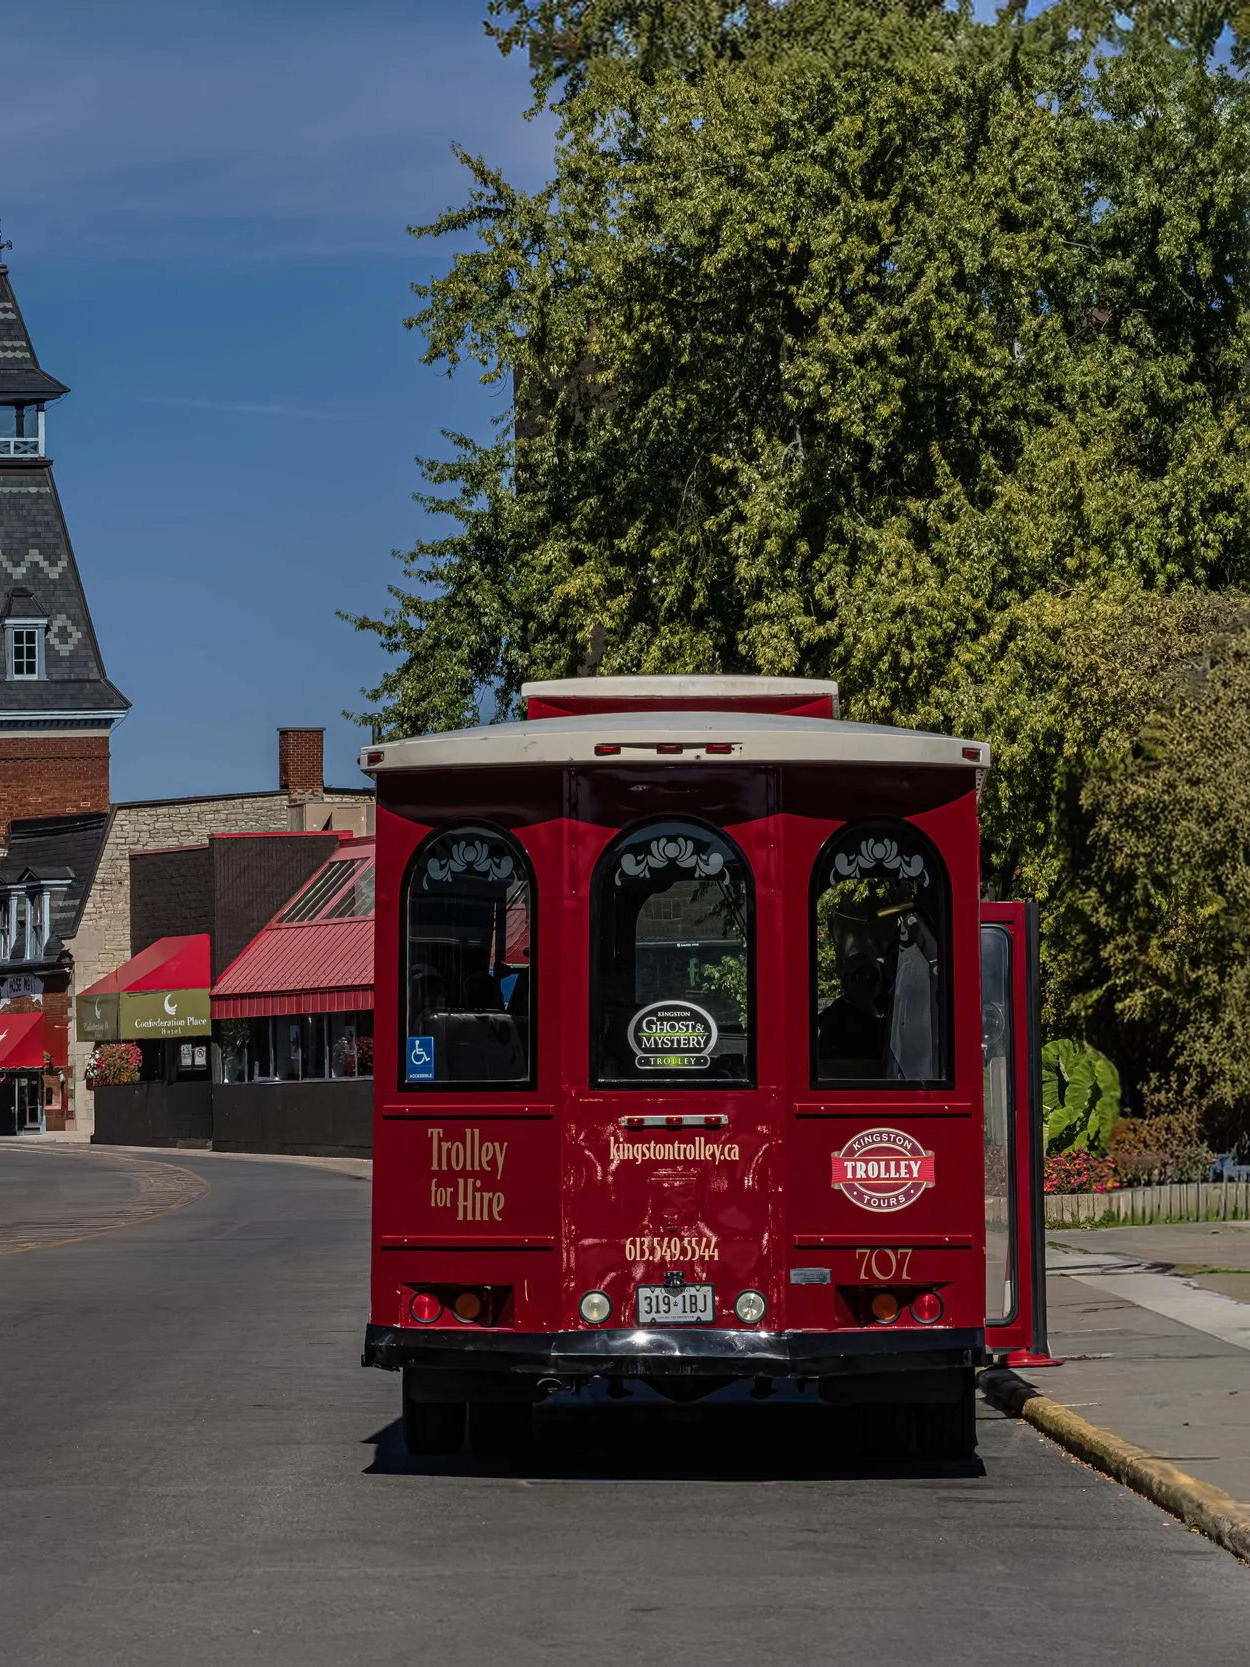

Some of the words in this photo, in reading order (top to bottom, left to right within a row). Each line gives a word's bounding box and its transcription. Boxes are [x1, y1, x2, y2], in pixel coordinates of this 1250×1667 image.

[135, 1019, 185, 1029] Confederation
[187, 1016, 207, 1026] Place
[161, 1027, 182, 1035] Hotel
[641, 1036, 707, 1048] MYSTERY
[649, 1057, 697, 1065] TROLLEY
[609, 1136, 740, 1165] kingstontrolley.ca
[852, 1133, 913, 1151] KINGSTON
[427, 1128, 508, 1180] Trolley
[844, 1160, 922, 1179] TROLLEY
[431, 1178, 453, 1207] for
[457, 1178, 505, 1221] Hire
[863, 1194, 906, 1207] TOURS
[625, 1237, 719, 1261] 613.549.5544
[855, 1247, 913, 1281] 707
[644, 1295, 671, 1314] 319
[682, 1294, 707, 1314] 1BJ
